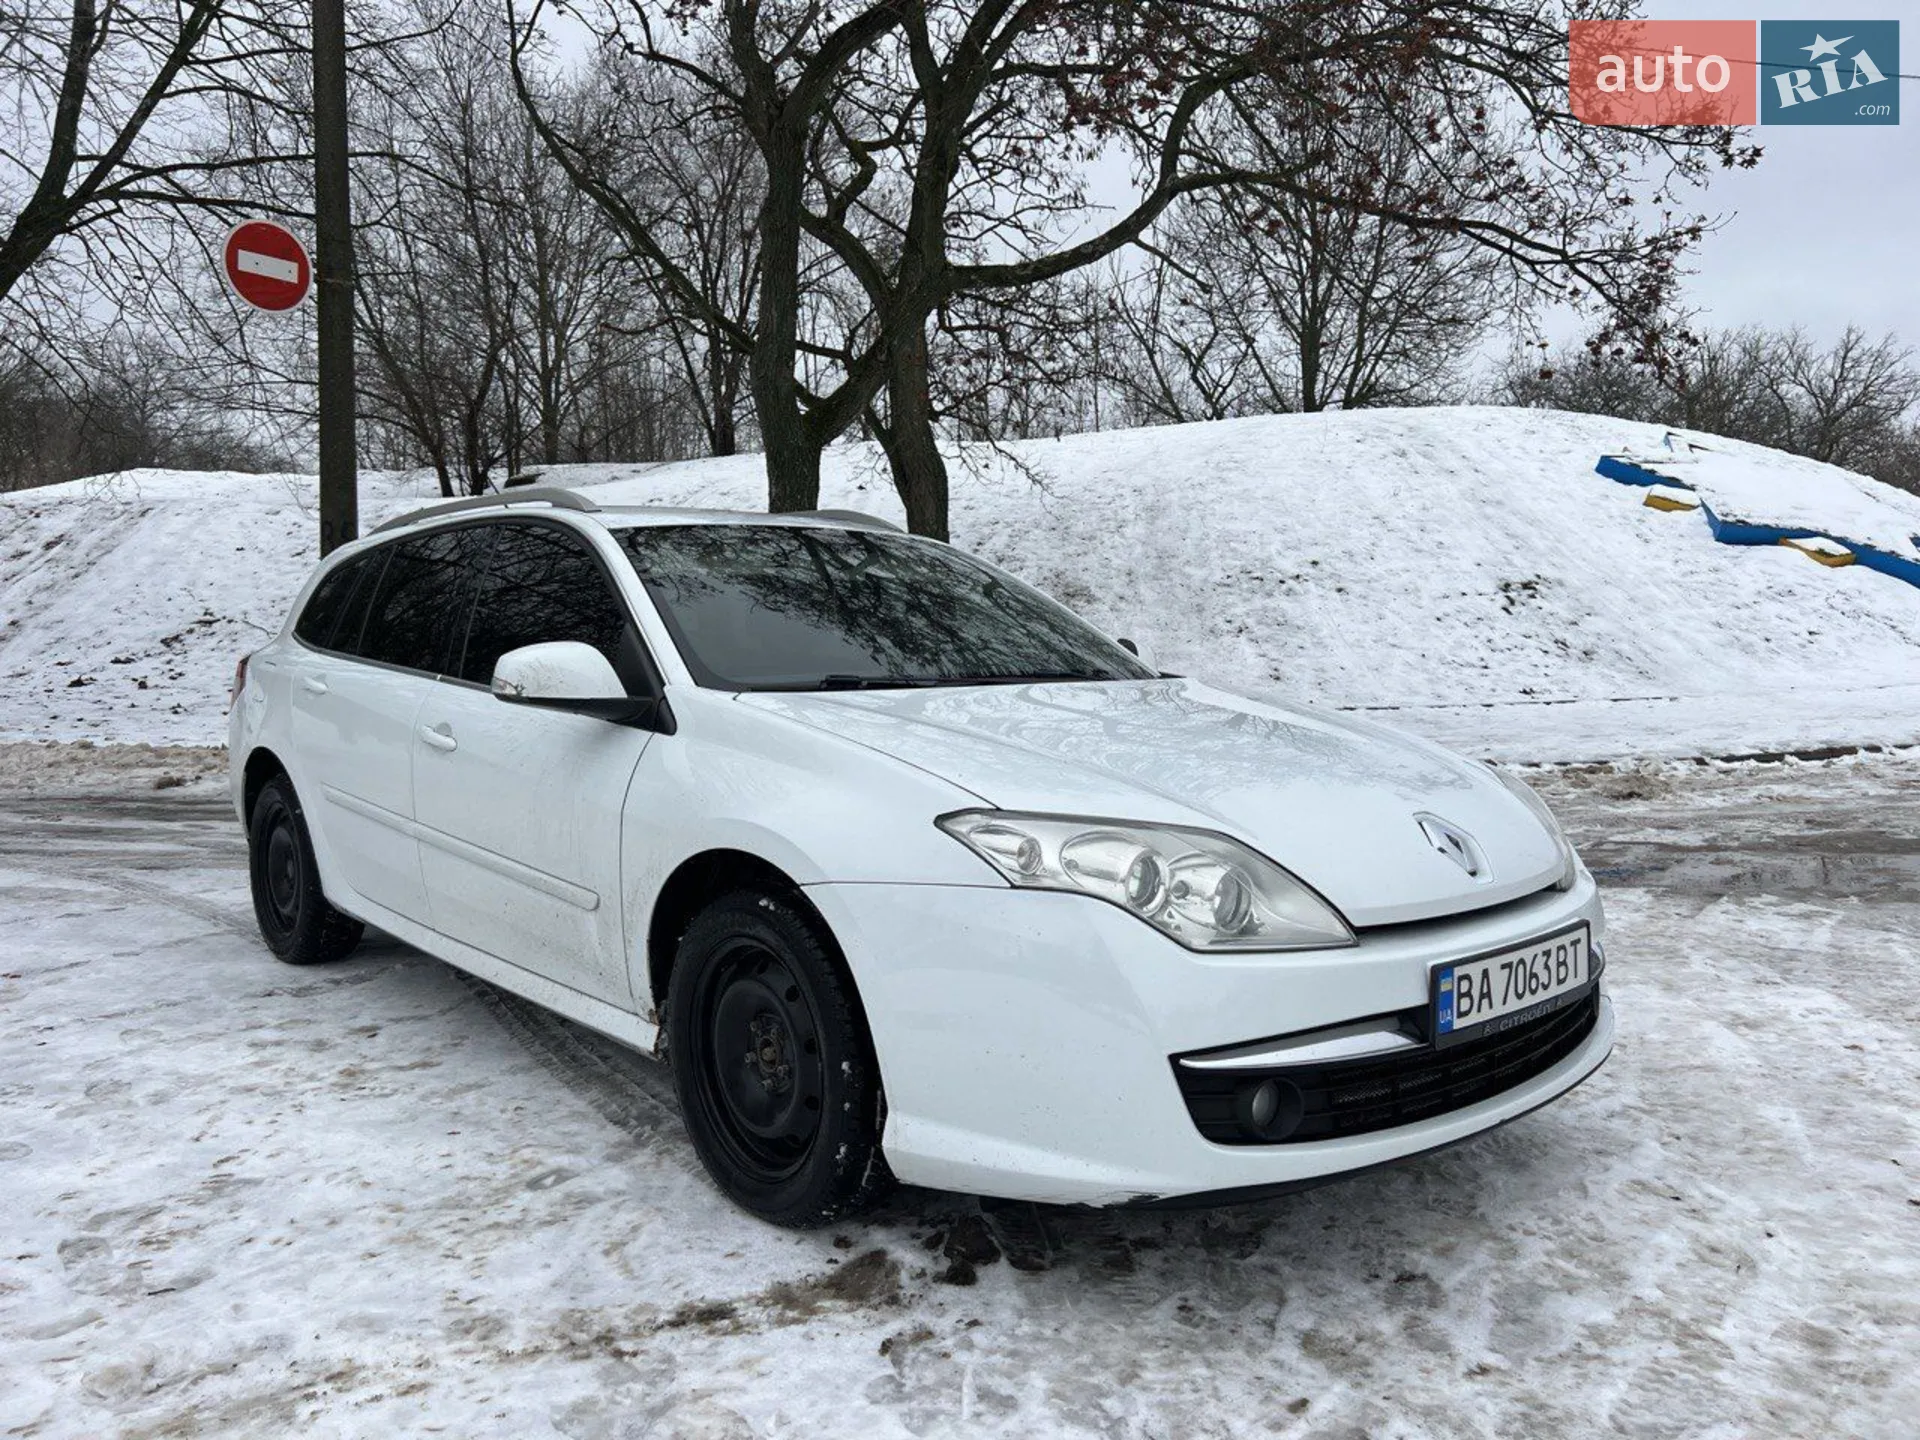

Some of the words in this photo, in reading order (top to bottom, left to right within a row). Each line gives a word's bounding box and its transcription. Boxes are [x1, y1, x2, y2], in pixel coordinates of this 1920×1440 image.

[1457, 968, 1493, 1019] BA
[1501, 948, 1552, 1005] 7063
[1556, 938, 1581, 985] BT
[1440, 1008, 1453, 1023] UA
